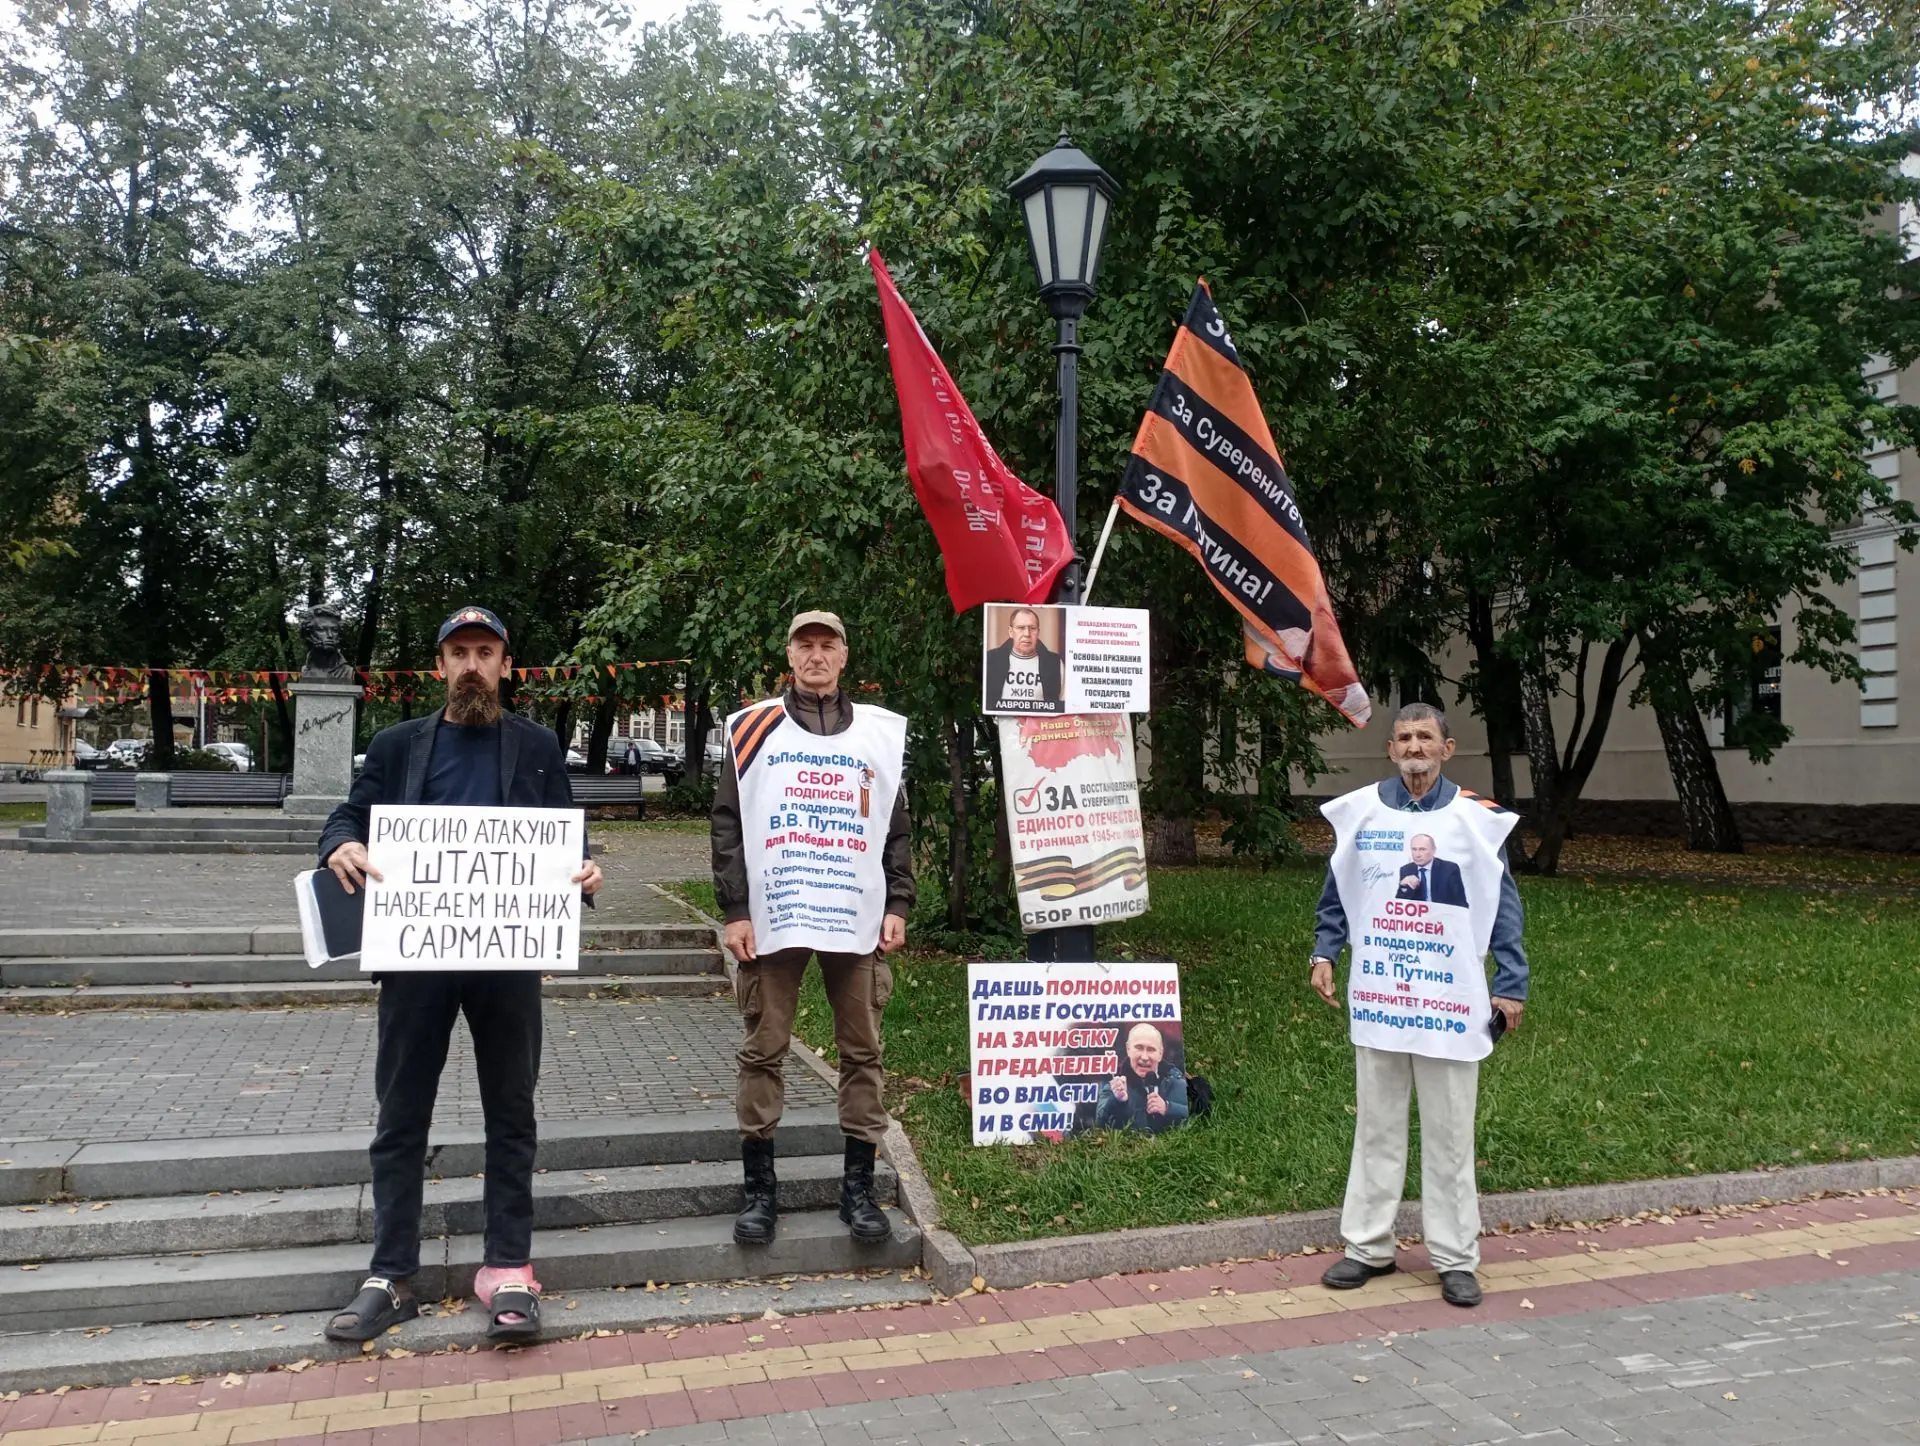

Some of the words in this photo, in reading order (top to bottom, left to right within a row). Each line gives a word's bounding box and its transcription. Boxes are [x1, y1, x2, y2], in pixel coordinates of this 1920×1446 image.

[1172, 394, 1193, 427] За
[1139, 474, 1177, 515] За
[1103, 653, 1141, 663] ПРИЗНАНИЯ
[1006, 671, 1042, 686] СССР
[1073, 665, 1104, 673] УКРАИНЫ
[1111, 666, 1143, 675] КАЧЕСТВЕ
[1081, 677, 1133, 686] НЕЗАВИСИМОГО
[1010, 688, 1035, 698] ЖИВ
[1085, 688, 1131, 698] ГОСУДАРСТВА
[996, 700, 1031, 710] ЛАВРОВ
[1032, 702, 1055, 710] ПРАВ
[1040, 720, 1070, 730] Наше
[797, 771, 844, 786] СБОР
[785, 787, 854, 802] ПОДПИСЕЙ
[1045, 785, 1078, 812] ЗА
[1081, 795, 1130, 808] СУВЕРЕНИТЕТА
[780, 803, 787, 812] в
[791, 803, 857, 819] поддержку
[770, 813, 802, 830] В.В.
[808, 815, 864, 835] Путина
[1016, 814, 1085, 835] ЕДИНОГО
[1089, 808, 1140, 826] ОТЕЧЕСТВА
[377, 817, 467, 844] РОССИЮ
[474, 818, 571, 845] АТАКУЮТ
[765, 835, 785, 850] для
[789, 832, 834, 848] Победы
[837, 839, 844, 847] в
[847, 838, 867, 852] СВО
[1019, 839, 1026, 849] в
[1030, 834, 1089, 851] границах
[782, 849, 807, 859] План
[412, 850, 535, 886] ШТАТЫ
[772, 865, 825, 876] Суверенитет
[827, 868, 856, 878] России
[766, 889, 799, 901] Украины
[374, 891, 484, 918] НАВЕДЕМ
[495, 893, 520, 918] НА
[528, 893, 571, 920] НИХ
[1385, 901, 1429, 917] СБОР
[1022, 908, 1072, 925] СБОР
[1372, 918, 1444, 936] ПОДПИСЕЙ
[1364, 936, 1371, 945] в
[1374, 936, 1455, 958] поддержку
[1388, 953, 1421, 964] КУРСА
[1363, 960, 1388, 976] В.В.
[1393, 964, 1454, 984] Путина
[1046, 980, 1177, 996] ПОЛНОМОЧИЯ
[1396, 983, 1410, 992] на
[1353, 990, 1420, 1008] СУВЕРЕНИТЕТ
[1423, 998, 1470, 1016] РОССИИ
[977, 1003, 1041, 1021] ГЛАВЕ
[1045, 1003, 1176, 1021] ГОСУДАРСТВА
[1352, 1007, 1466, 1034] ЗаПобедувСВО.РФ
[977, 1031, 1008, 1049] НА
[1012, 1029, 1118, 1048] ЗАЧИСТКУ
[977, 1052, 1118, 1078] ПРЕДАТЕЛЕЙ
[978, 1086, 1010, 1105] ВО
[1014, 1084, 1098, 1104] ВЛАСТИ
[979, 1115, 995, 1132] И
[1000, 1115, 1014, 1132] В
[1018, 1113, 1074, 1131] СМИ!
